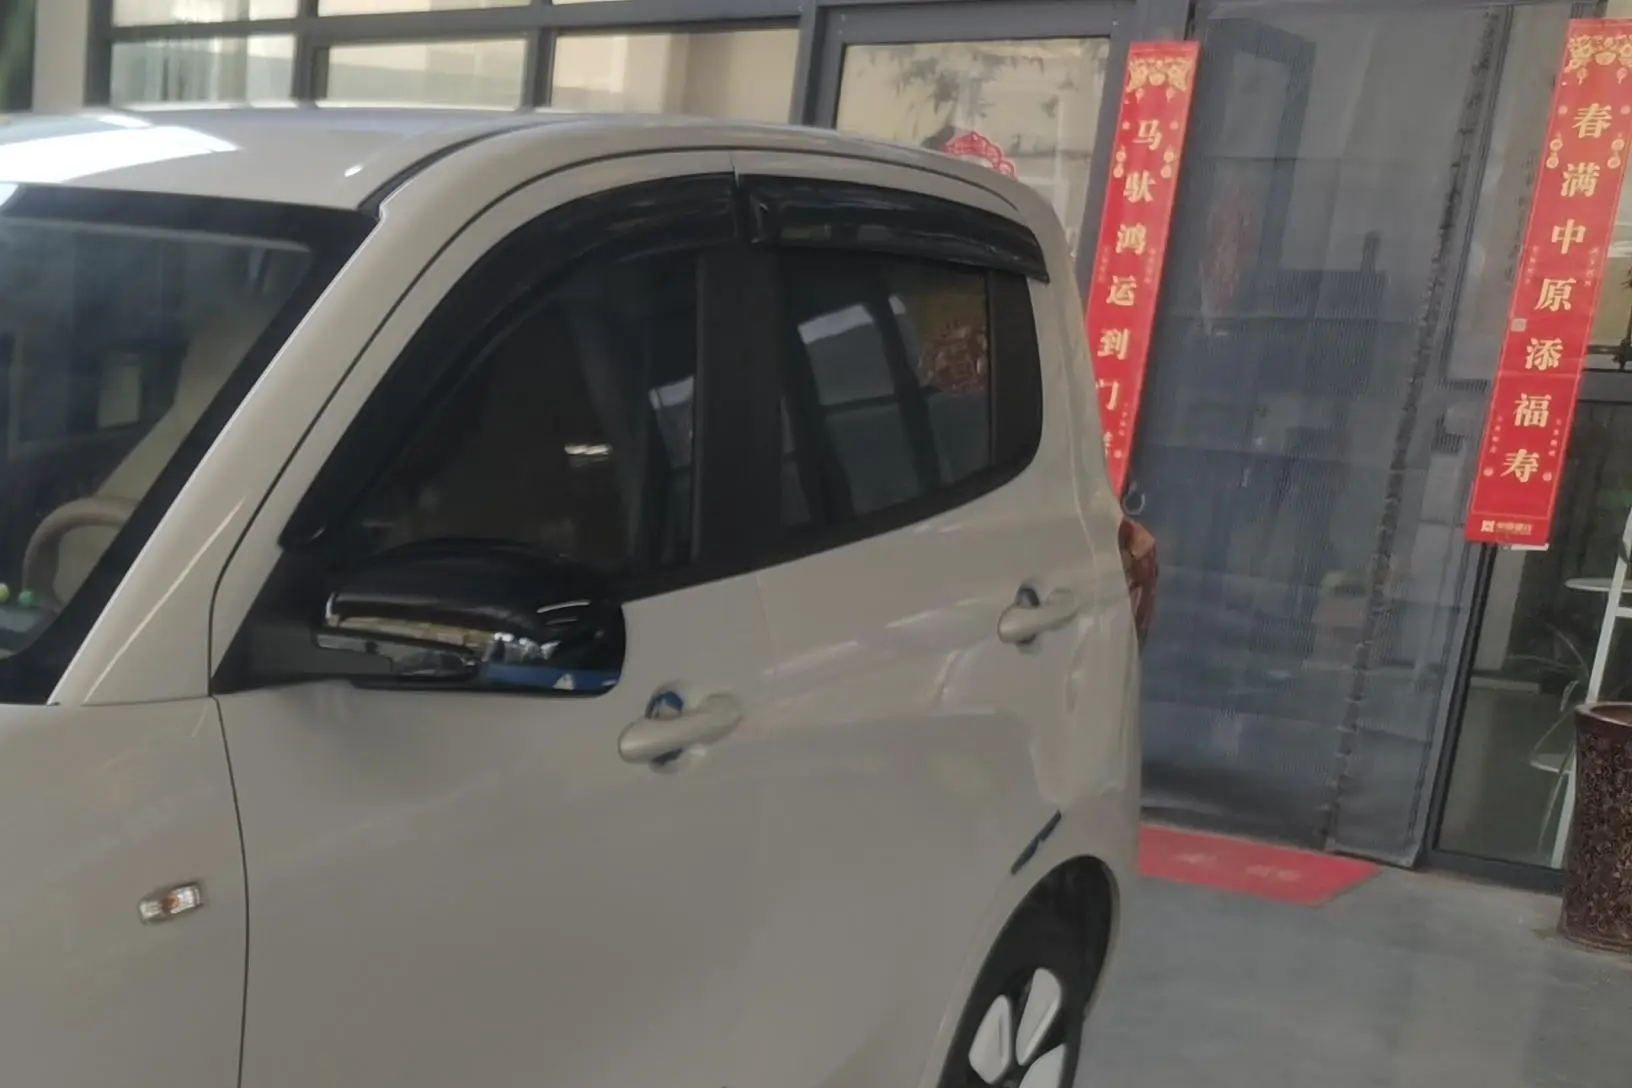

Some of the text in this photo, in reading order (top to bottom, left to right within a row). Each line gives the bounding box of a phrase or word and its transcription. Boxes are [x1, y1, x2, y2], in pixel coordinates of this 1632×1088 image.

[1499, 102, 1613, 483] 春满中原添福寿
